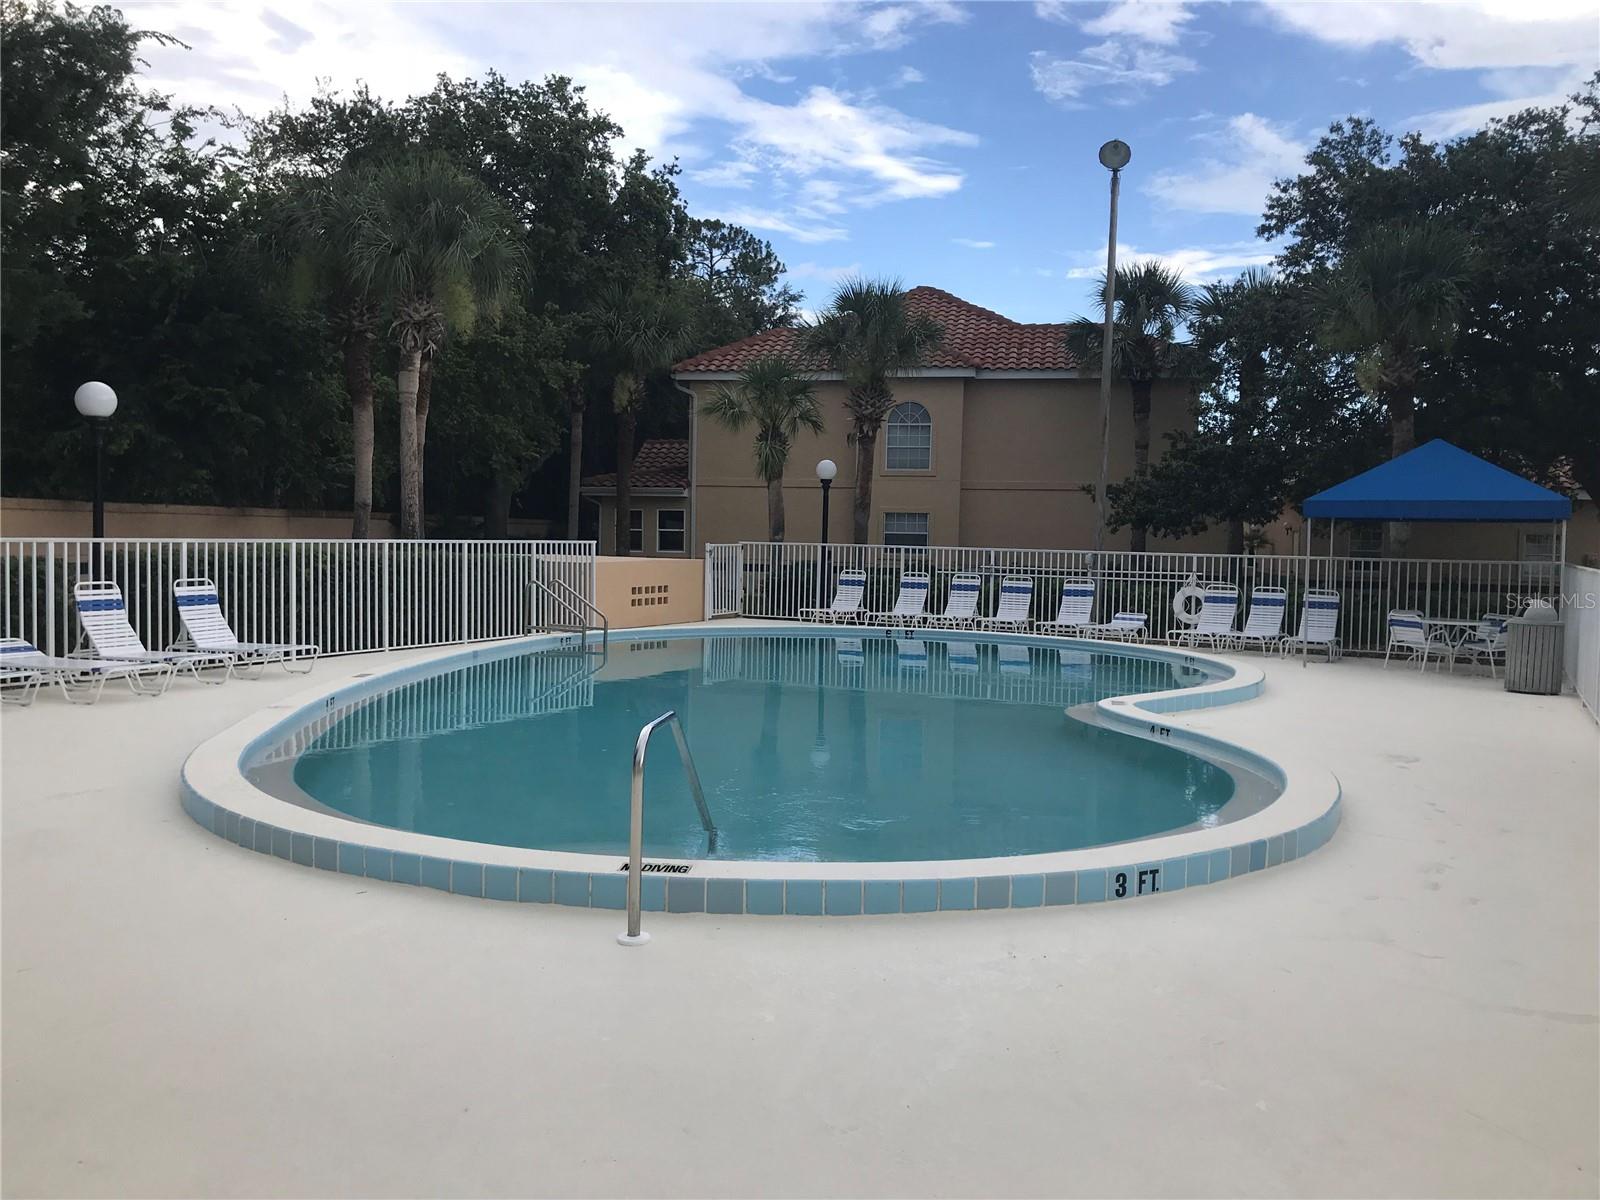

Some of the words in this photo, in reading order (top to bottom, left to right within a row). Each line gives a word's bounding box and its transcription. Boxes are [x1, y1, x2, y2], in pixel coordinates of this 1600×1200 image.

[641, 863, 690, 874] DIVING
[1115, 872, 1128, 898] 3
[1138, 868, 1160, 895] FT.
